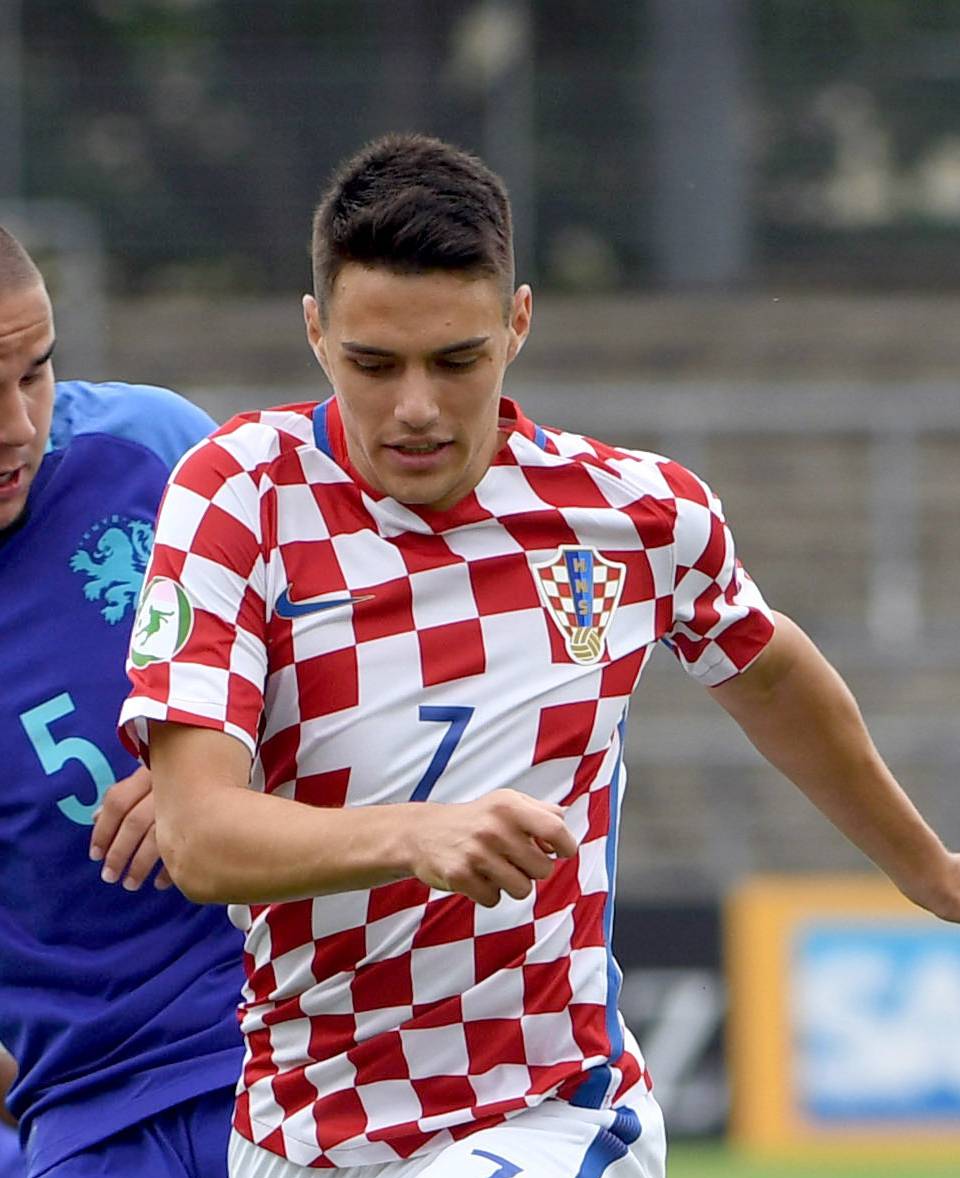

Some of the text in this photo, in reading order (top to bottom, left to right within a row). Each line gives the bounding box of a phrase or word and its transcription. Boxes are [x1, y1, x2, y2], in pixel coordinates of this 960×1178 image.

[572, 557, 589, 616] HNS
[19, 691, 117, 826] 5
[408, 704, 476, 803] 7
